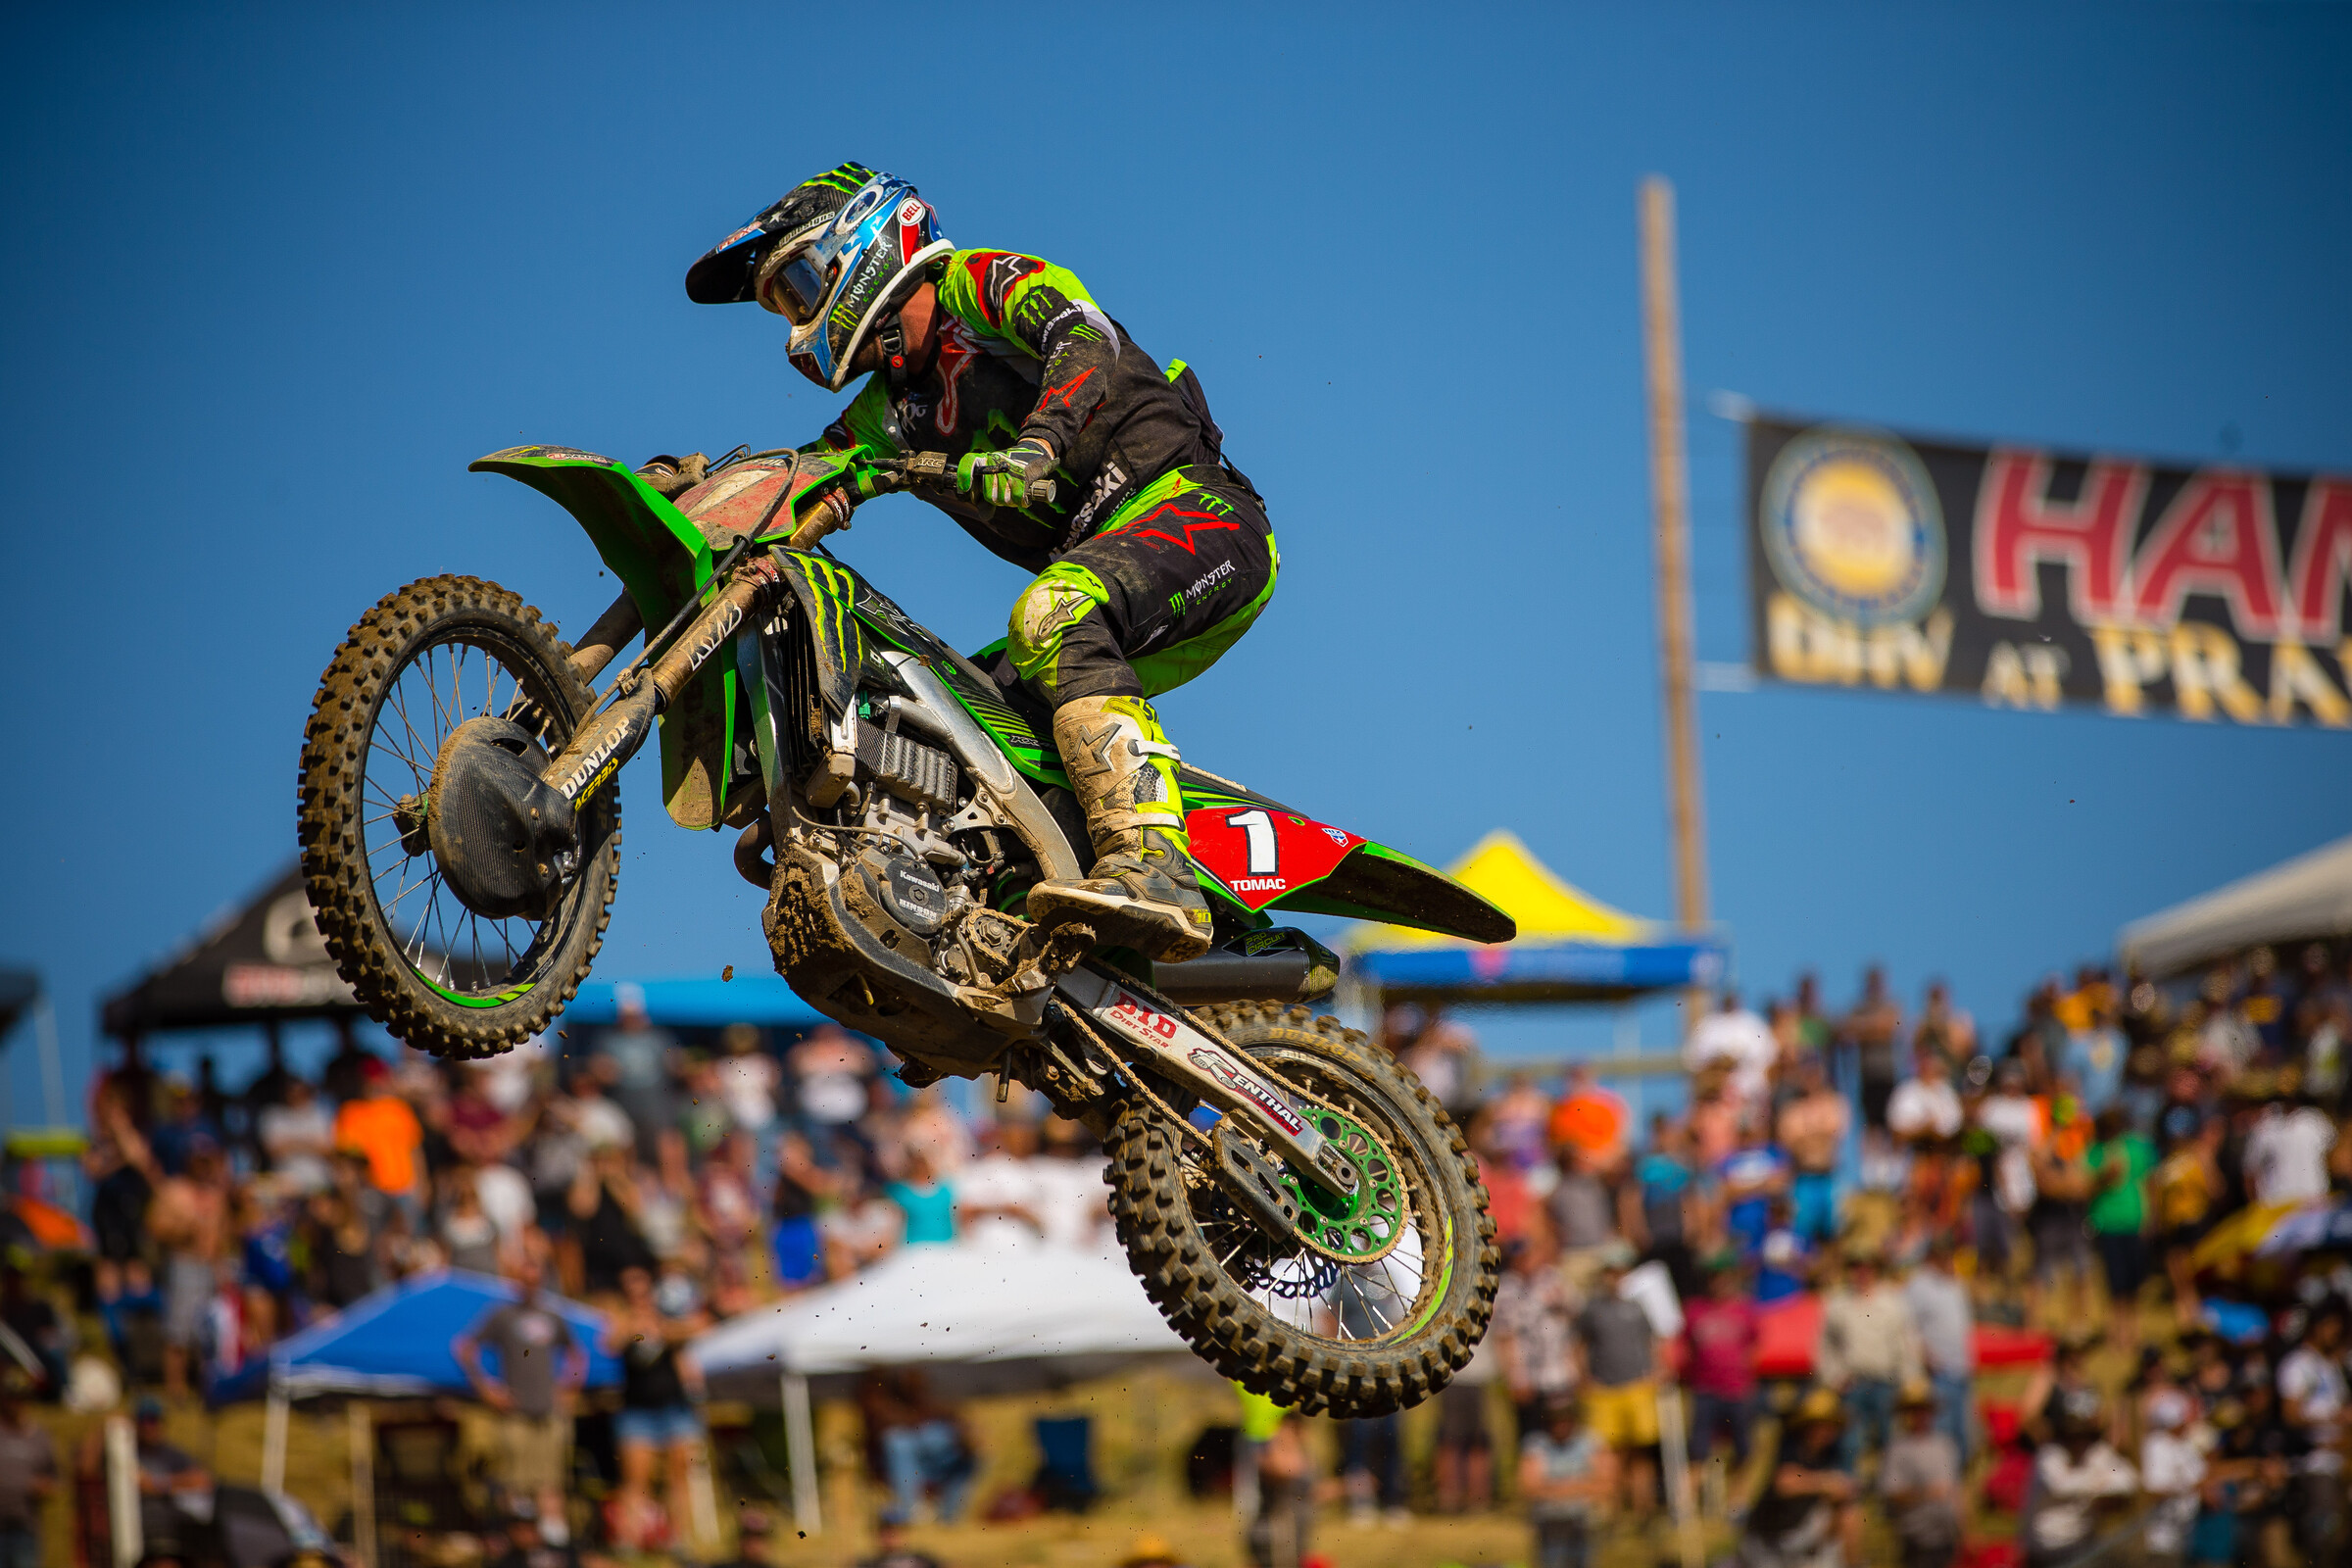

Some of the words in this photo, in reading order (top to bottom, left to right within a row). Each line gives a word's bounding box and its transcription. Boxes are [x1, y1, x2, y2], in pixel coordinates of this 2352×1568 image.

[902, 202, 921, 221] BELL
[847, 241, 893, 309] MONSTER
[1186, 560, 1236, 599] MONSTER
[1196, 577, 1233, 606] ENERGY
[2085, 619, 2352, 730] PRA
[560, 715, 630, 801] DUNLOP
[1226, 808, 1279, 877] 1
[900, 869, 940, 893] Kawasaki
[1230, 878, 1286, 892] TOMAC
[1246, 932, 1267, 946] PRO
[1247, 932, 1285, 955] CIRCUIT
[1109, 1009, 1140, 1030] DIRT
[1139, 1026, 1169, 1049] STAR
